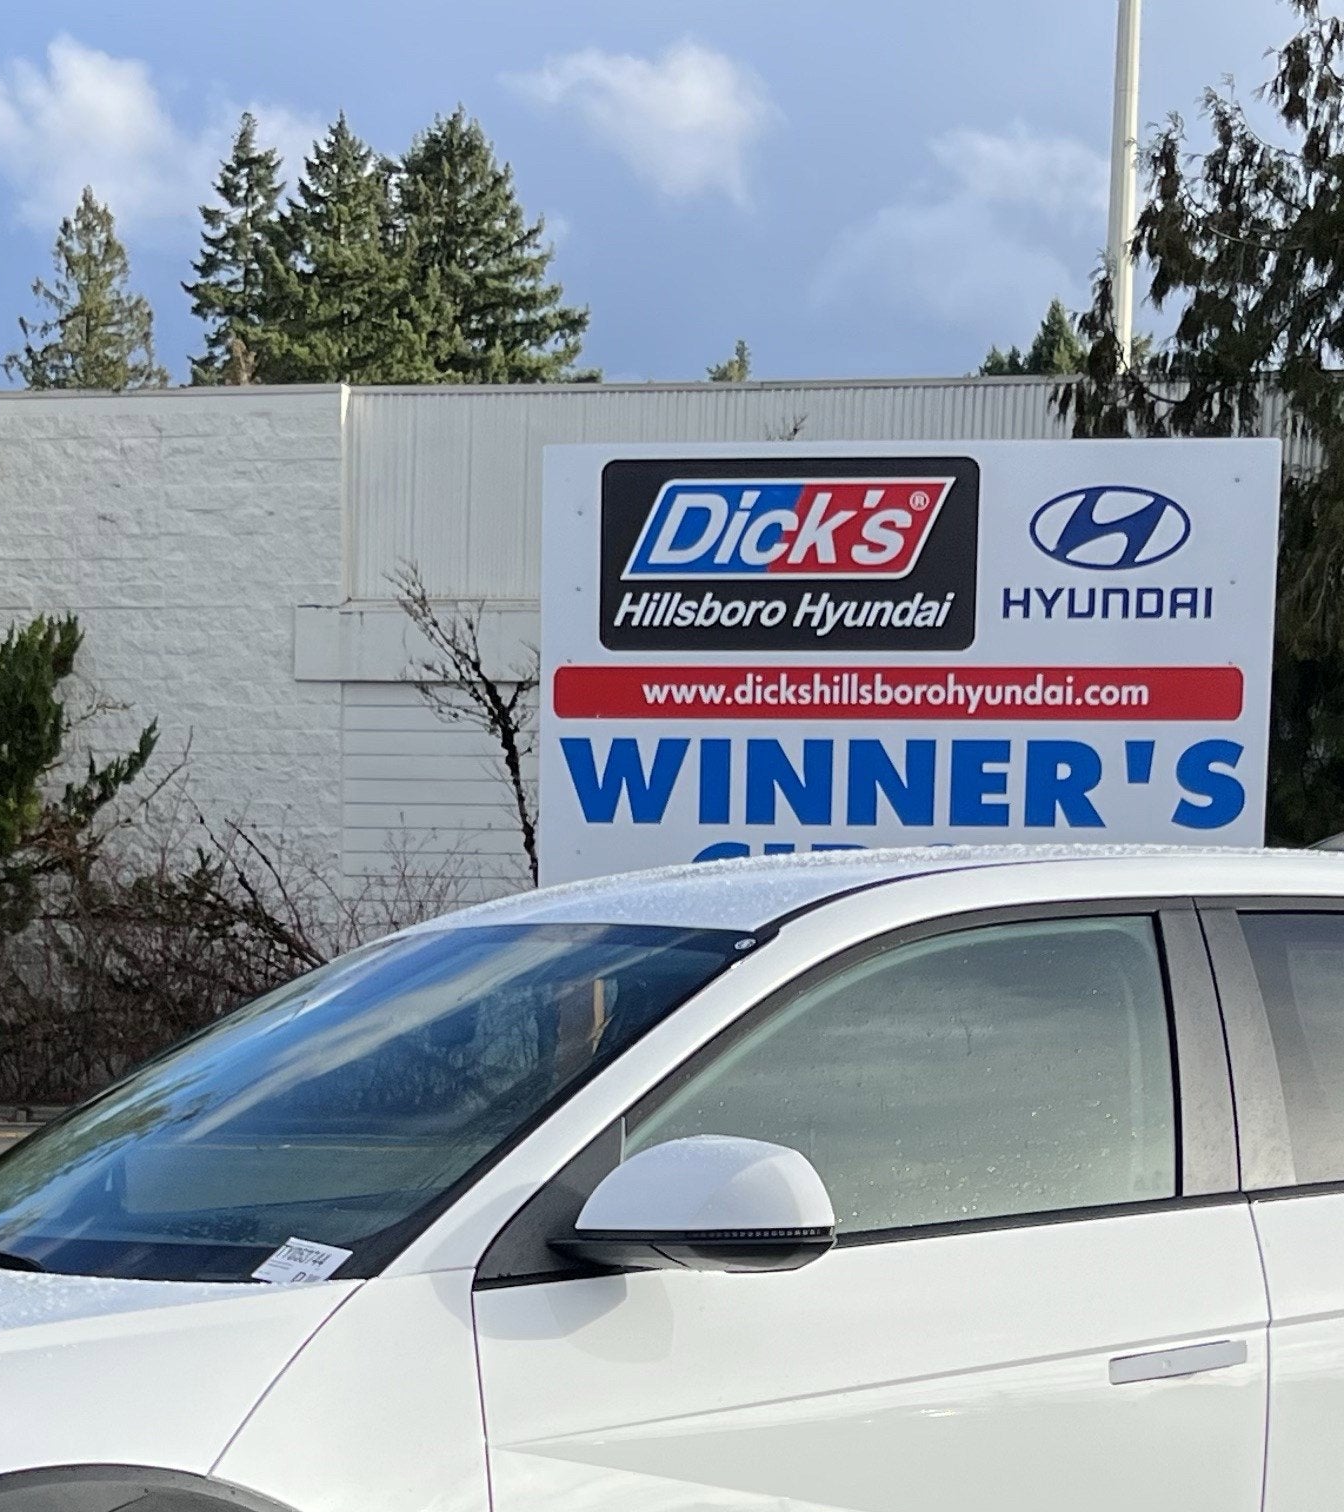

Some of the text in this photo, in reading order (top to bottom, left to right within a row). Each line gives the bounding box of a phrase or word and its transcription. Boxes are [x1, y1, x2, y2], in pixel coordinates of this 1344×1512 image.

[647, 489, 912, 566] Dick's
[613, 592, 956, 637] Hillsboro Hyundai
[1003, 587, 1212, 620] HYUNDAI
[642, 672, 1149, 713] www.dickshillsborohyundai.com
[559, 736, 1246, 830] WINNER'S
